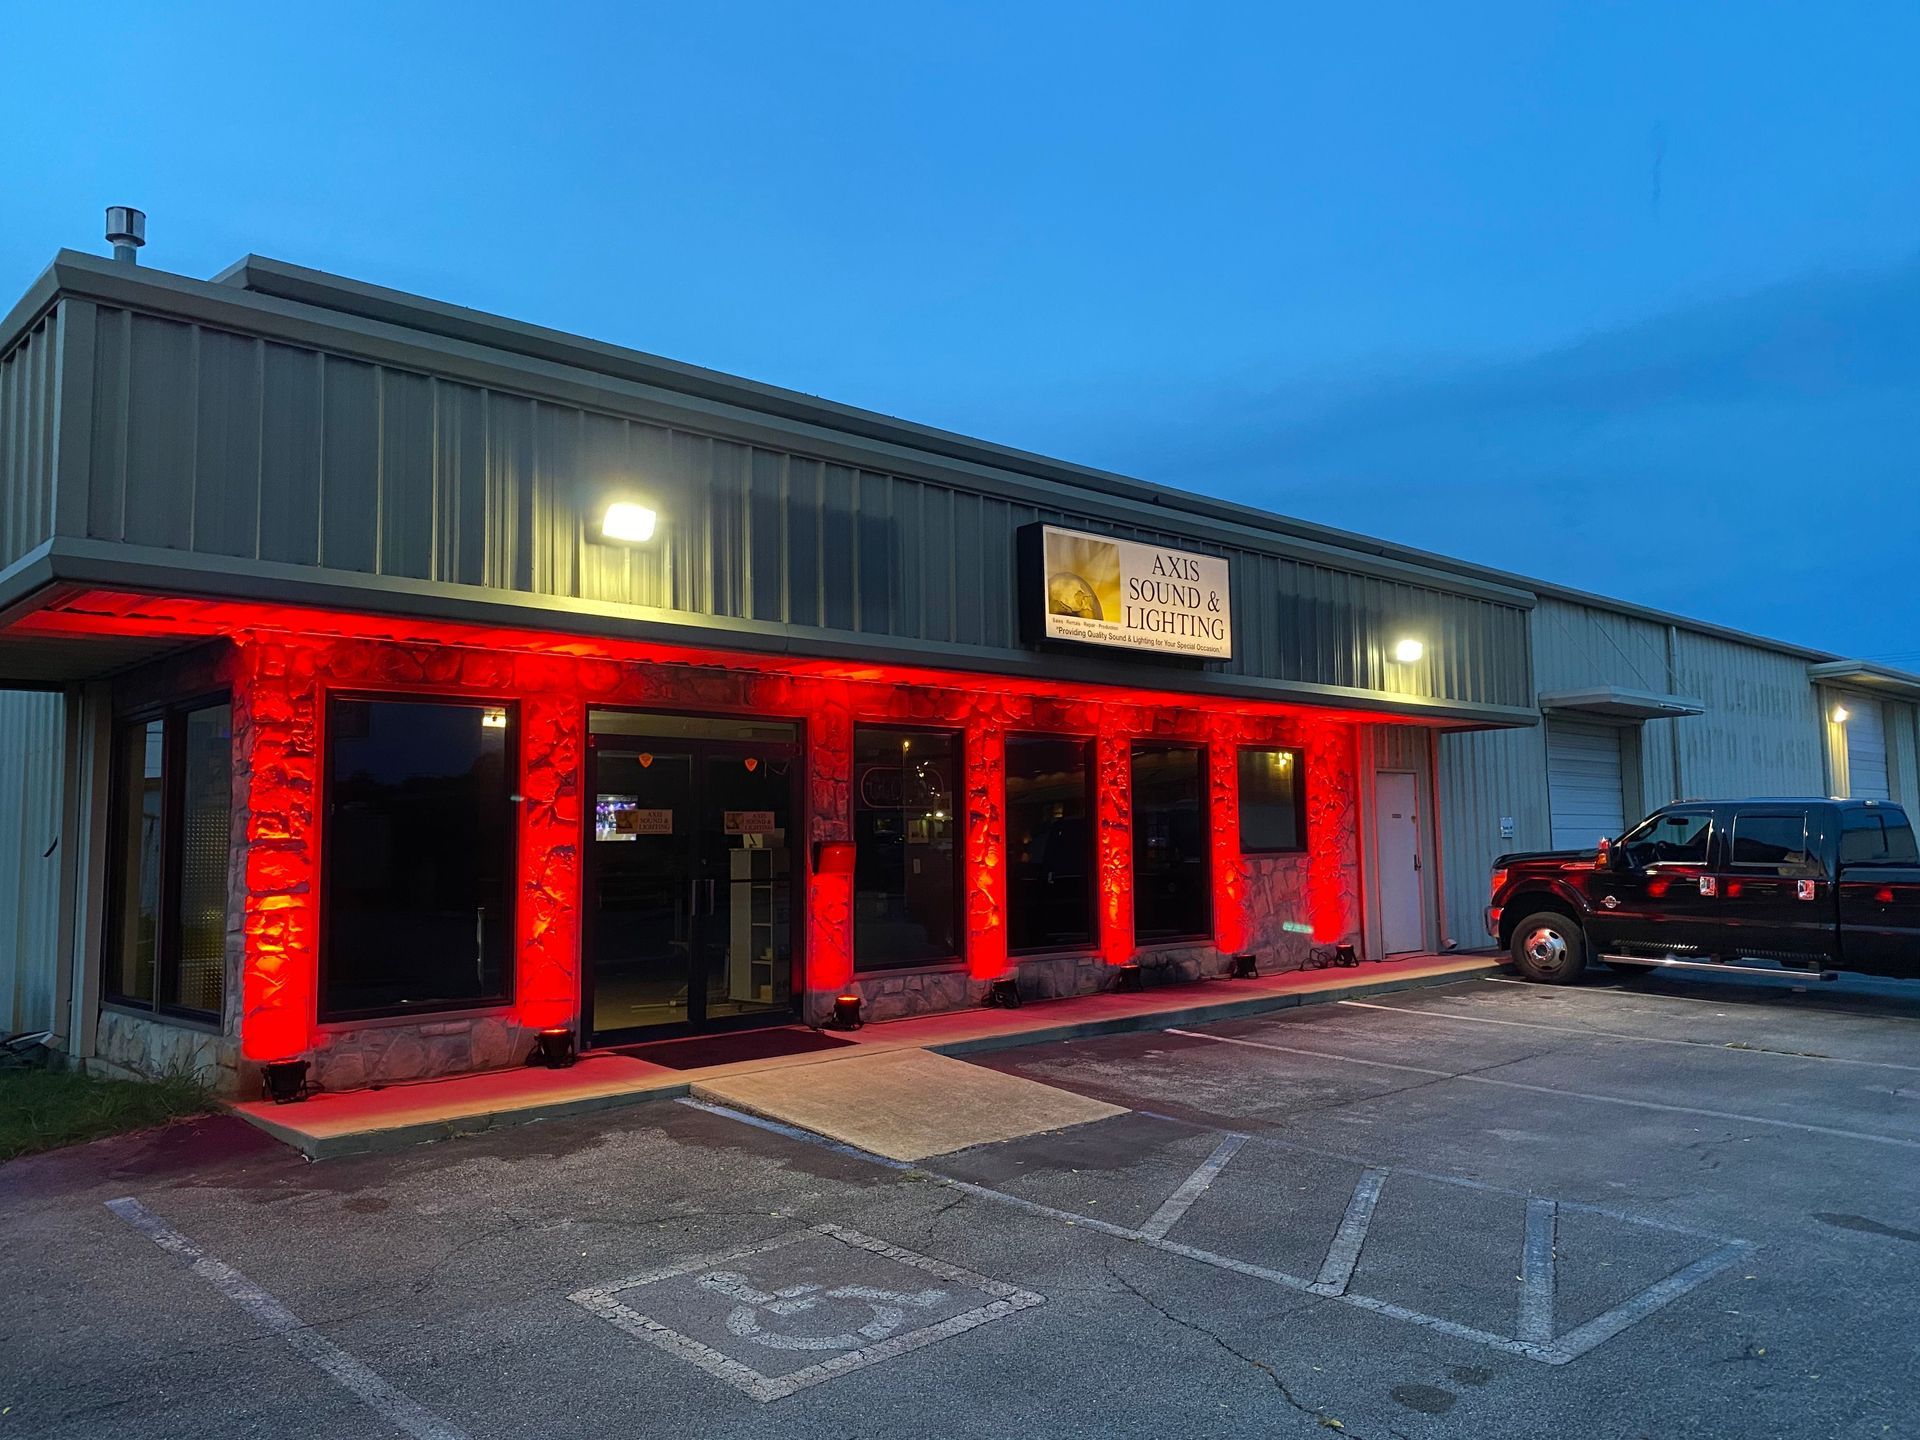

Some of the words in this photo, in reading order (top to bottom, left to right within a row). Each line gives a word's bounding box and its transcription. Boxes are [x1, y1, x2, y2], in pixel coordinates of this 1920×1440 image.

[1152, 553, 1200, 582] AXIS
[1129, 577, 1201, 609] SOUND
[1207, 591, 1220, 612] &
[1126, 605, 1224, 640] LIGHTING
[1087, 630, 1108, 640] Quality
[1108, 632, 1127, 641] Sound
[1132, 635, 1154, 646] Lighting
[1155, 638, 1163, 646] for
[1164, 639, 1176, 647] Your
[1177, 641, 1195, 650] Special
